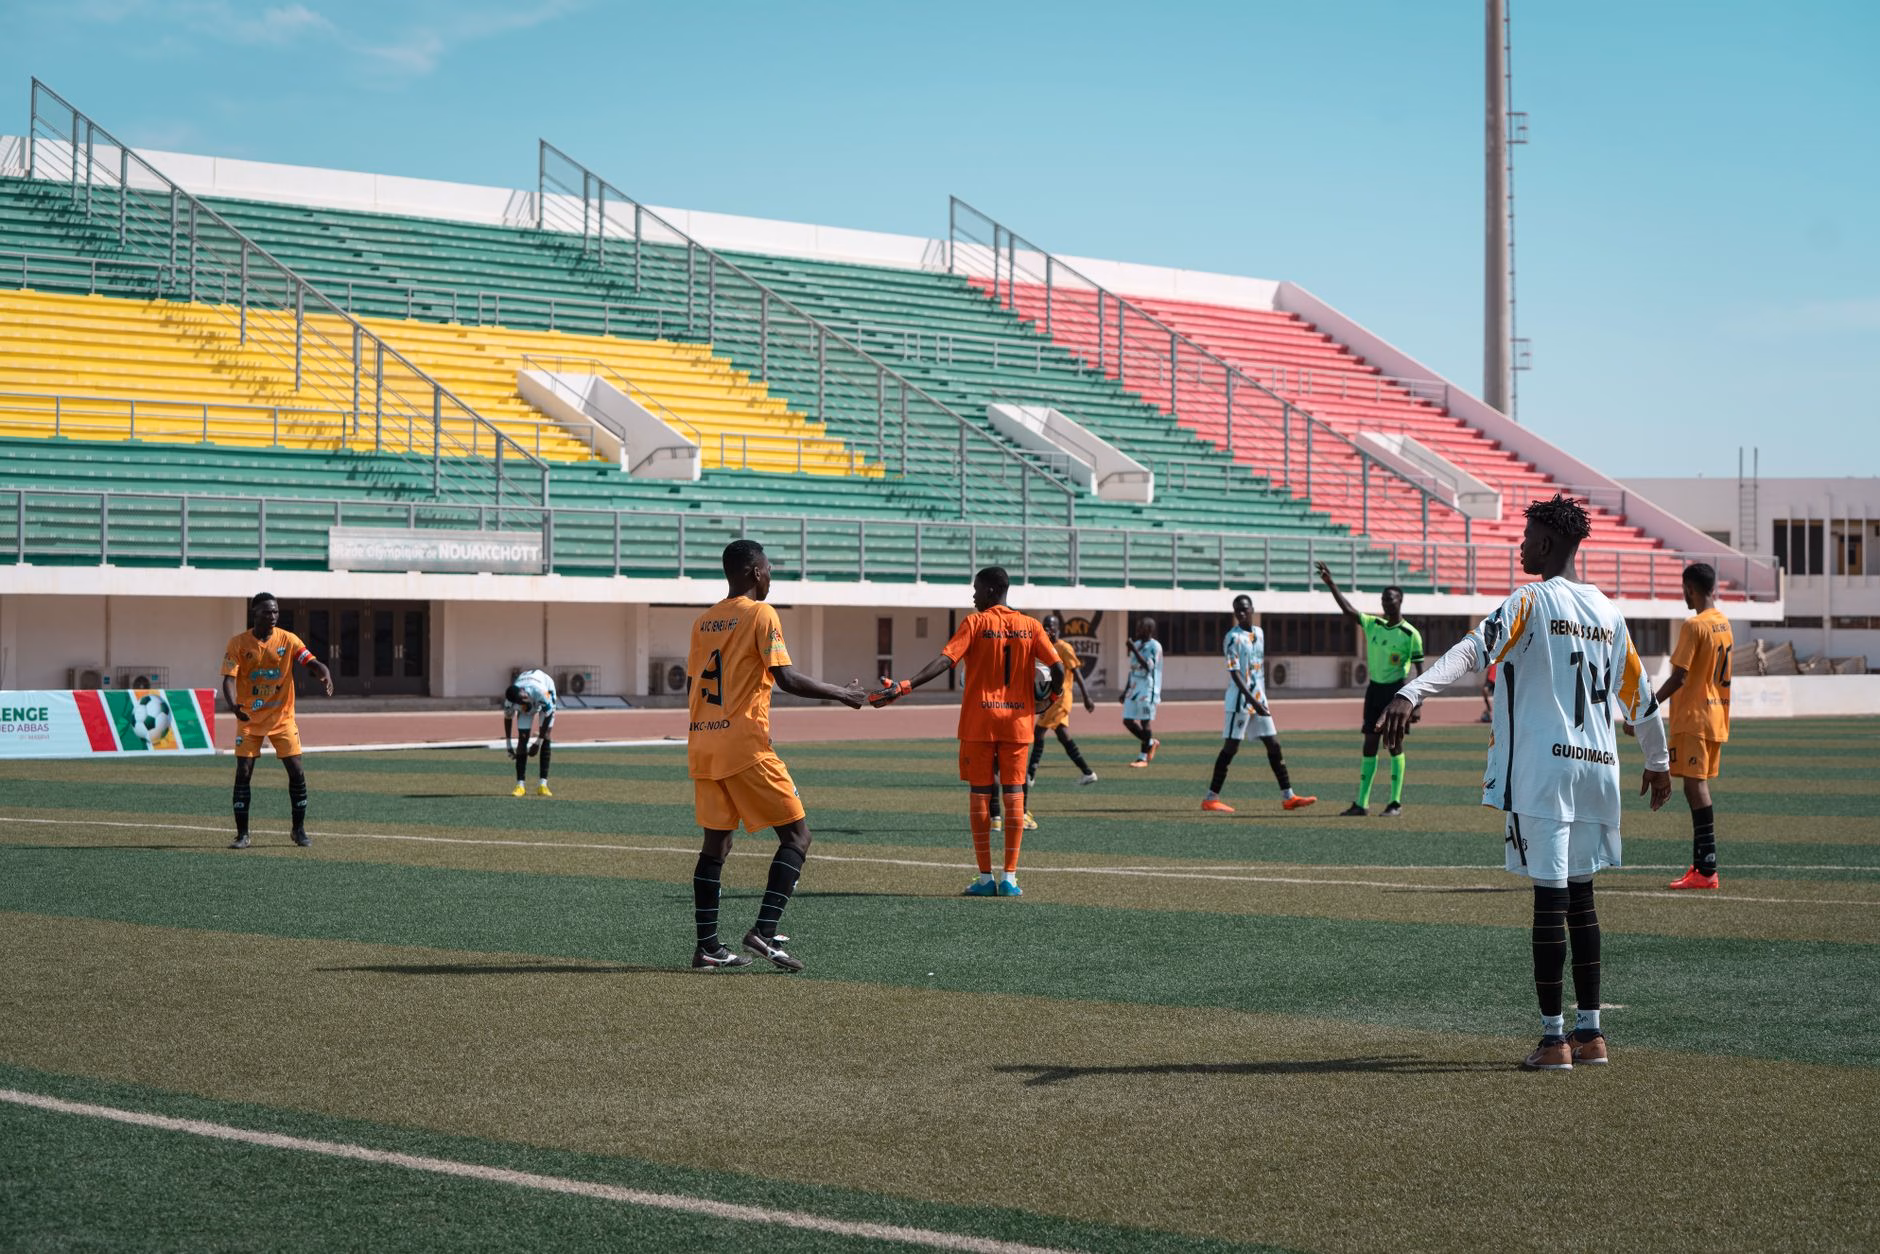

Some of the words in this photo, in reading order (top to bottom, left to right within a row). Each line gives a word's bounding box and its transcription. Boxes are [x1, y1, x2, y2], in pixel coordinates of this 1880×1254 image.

[367, 543, 424, 560] Olympique
[438, 543, 539, 561] NOUAKCHOTT
[1569, 651, 1611, 732] 14
[0, 707, 49, 721] ENGE
[17, 723, 49, 733] ABBAS
